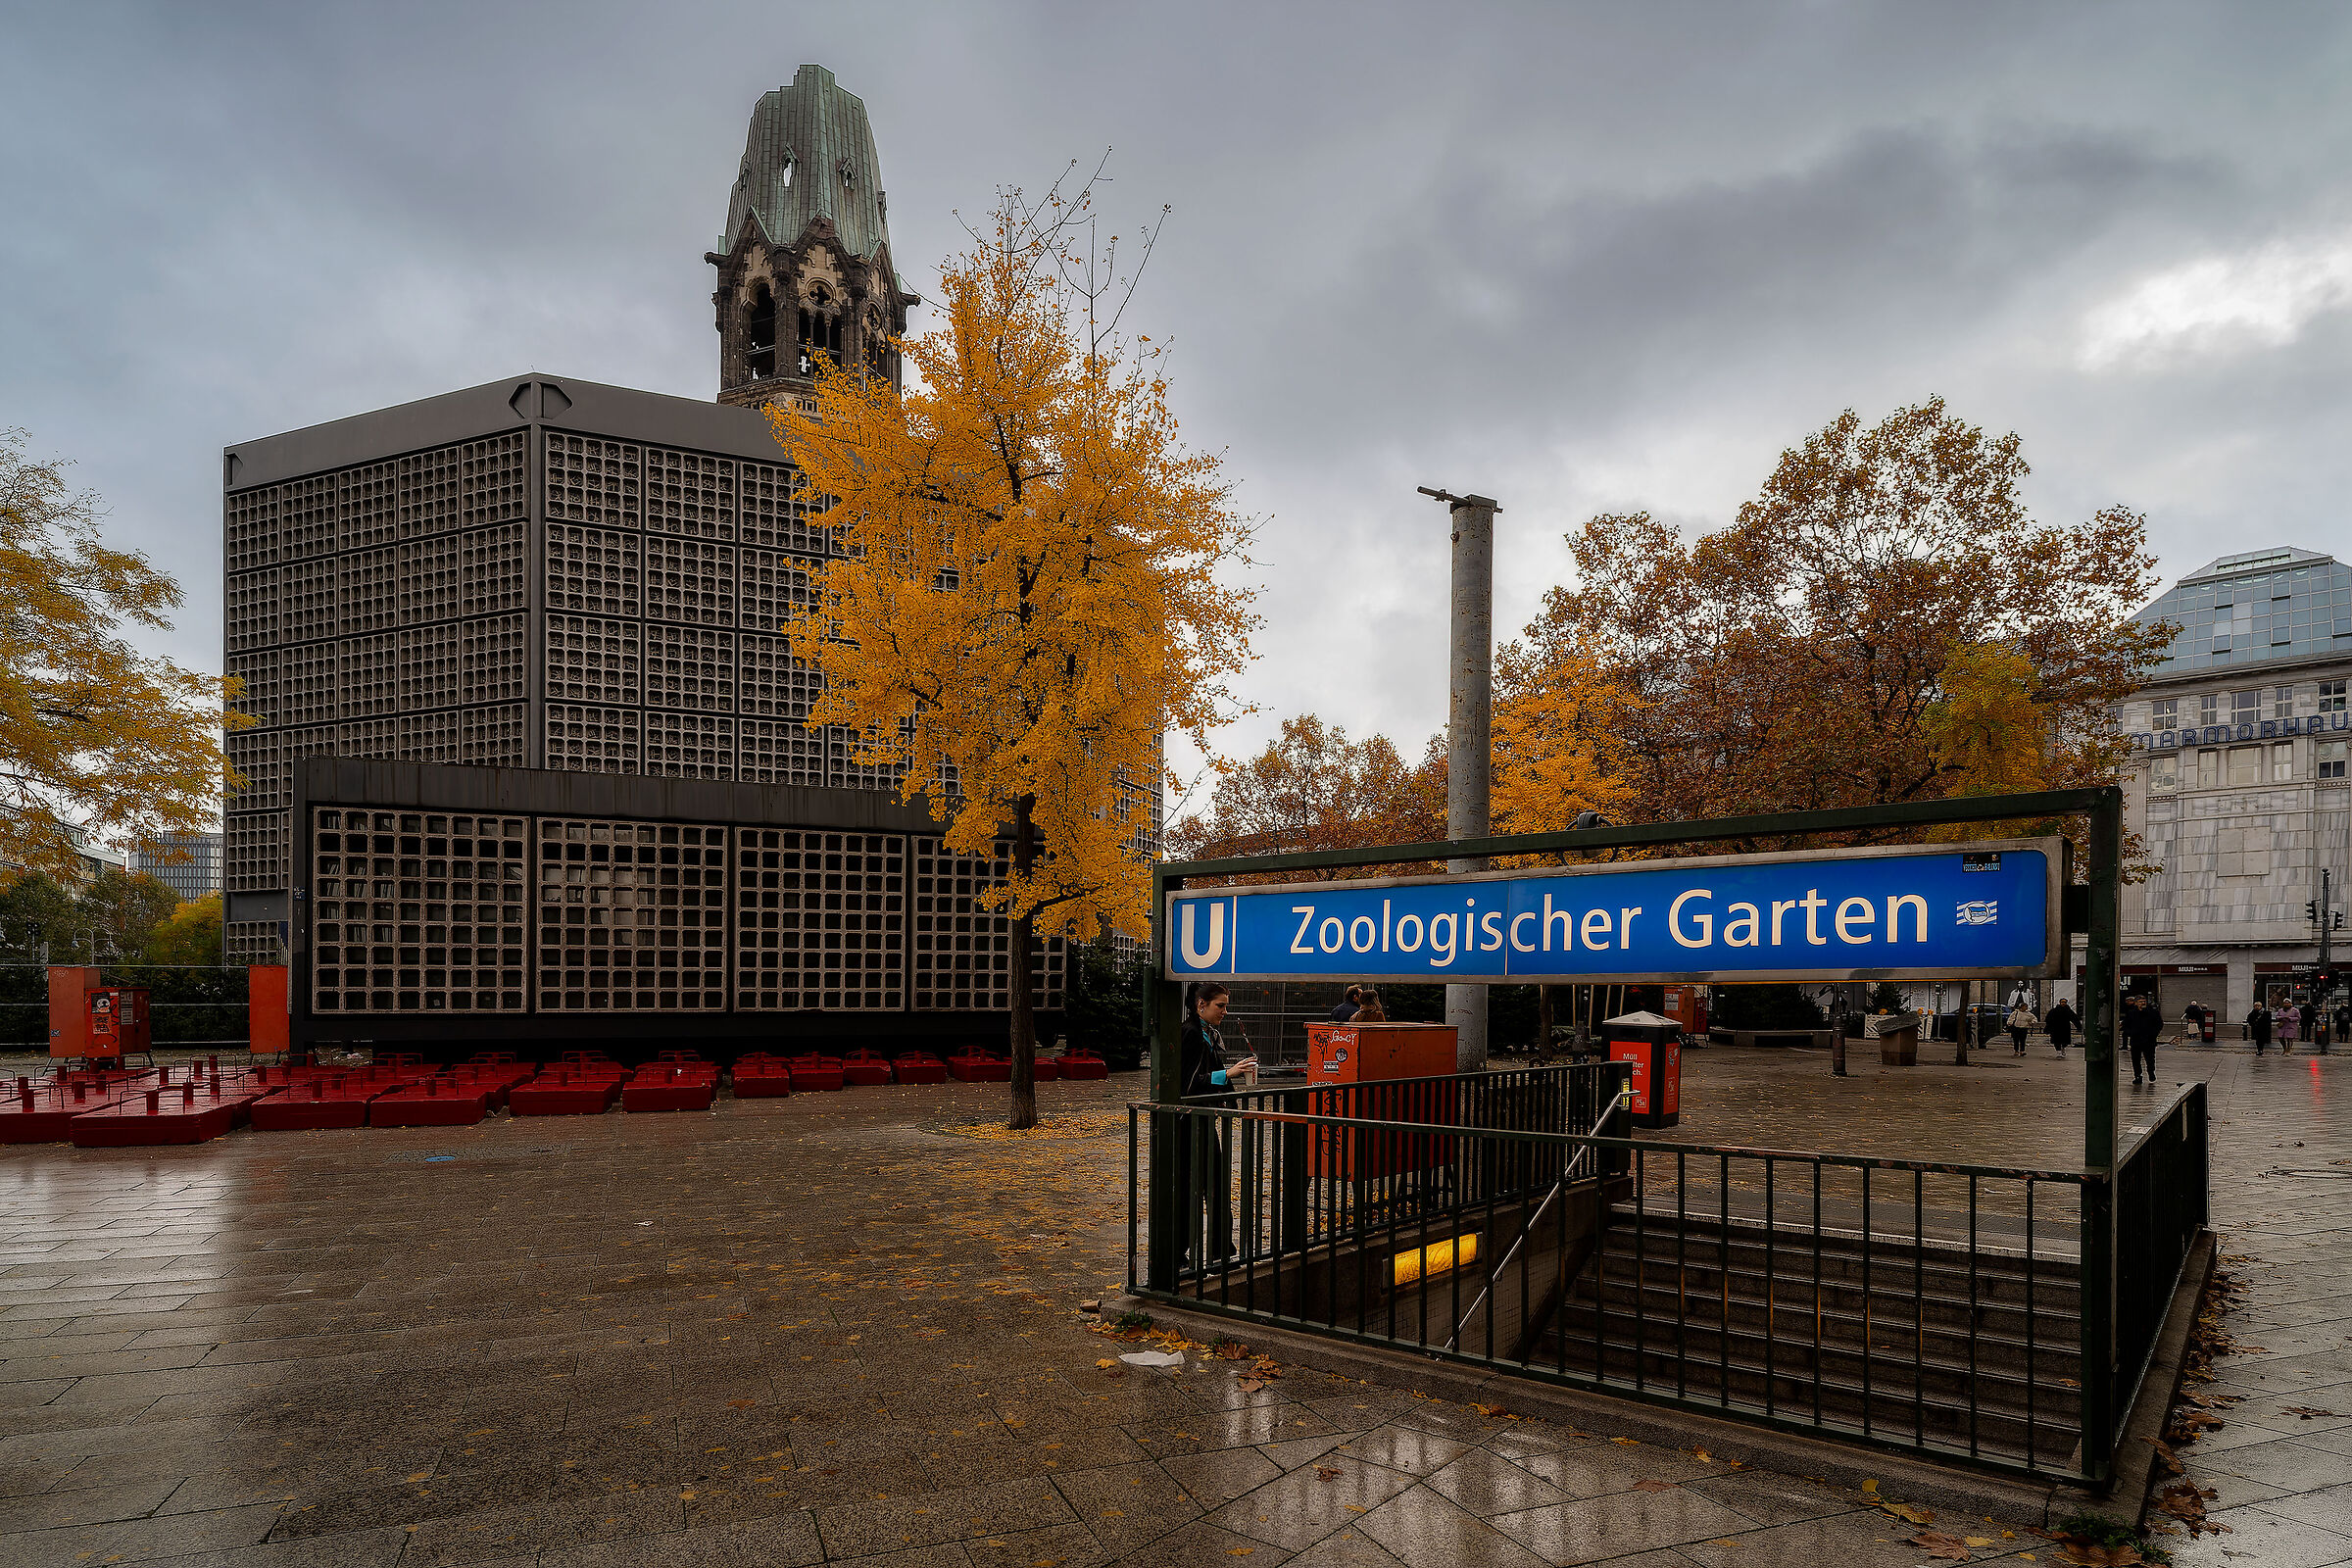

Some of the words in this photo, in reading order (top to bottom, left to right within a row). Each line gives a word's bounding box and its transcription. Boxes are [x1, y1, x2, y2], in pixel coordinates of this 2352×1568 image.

[1181, 903, 1224, 969] U
[1290, 893, 1642, 967] Zoologischer
[1668, 888, 1929, 949] Garten
